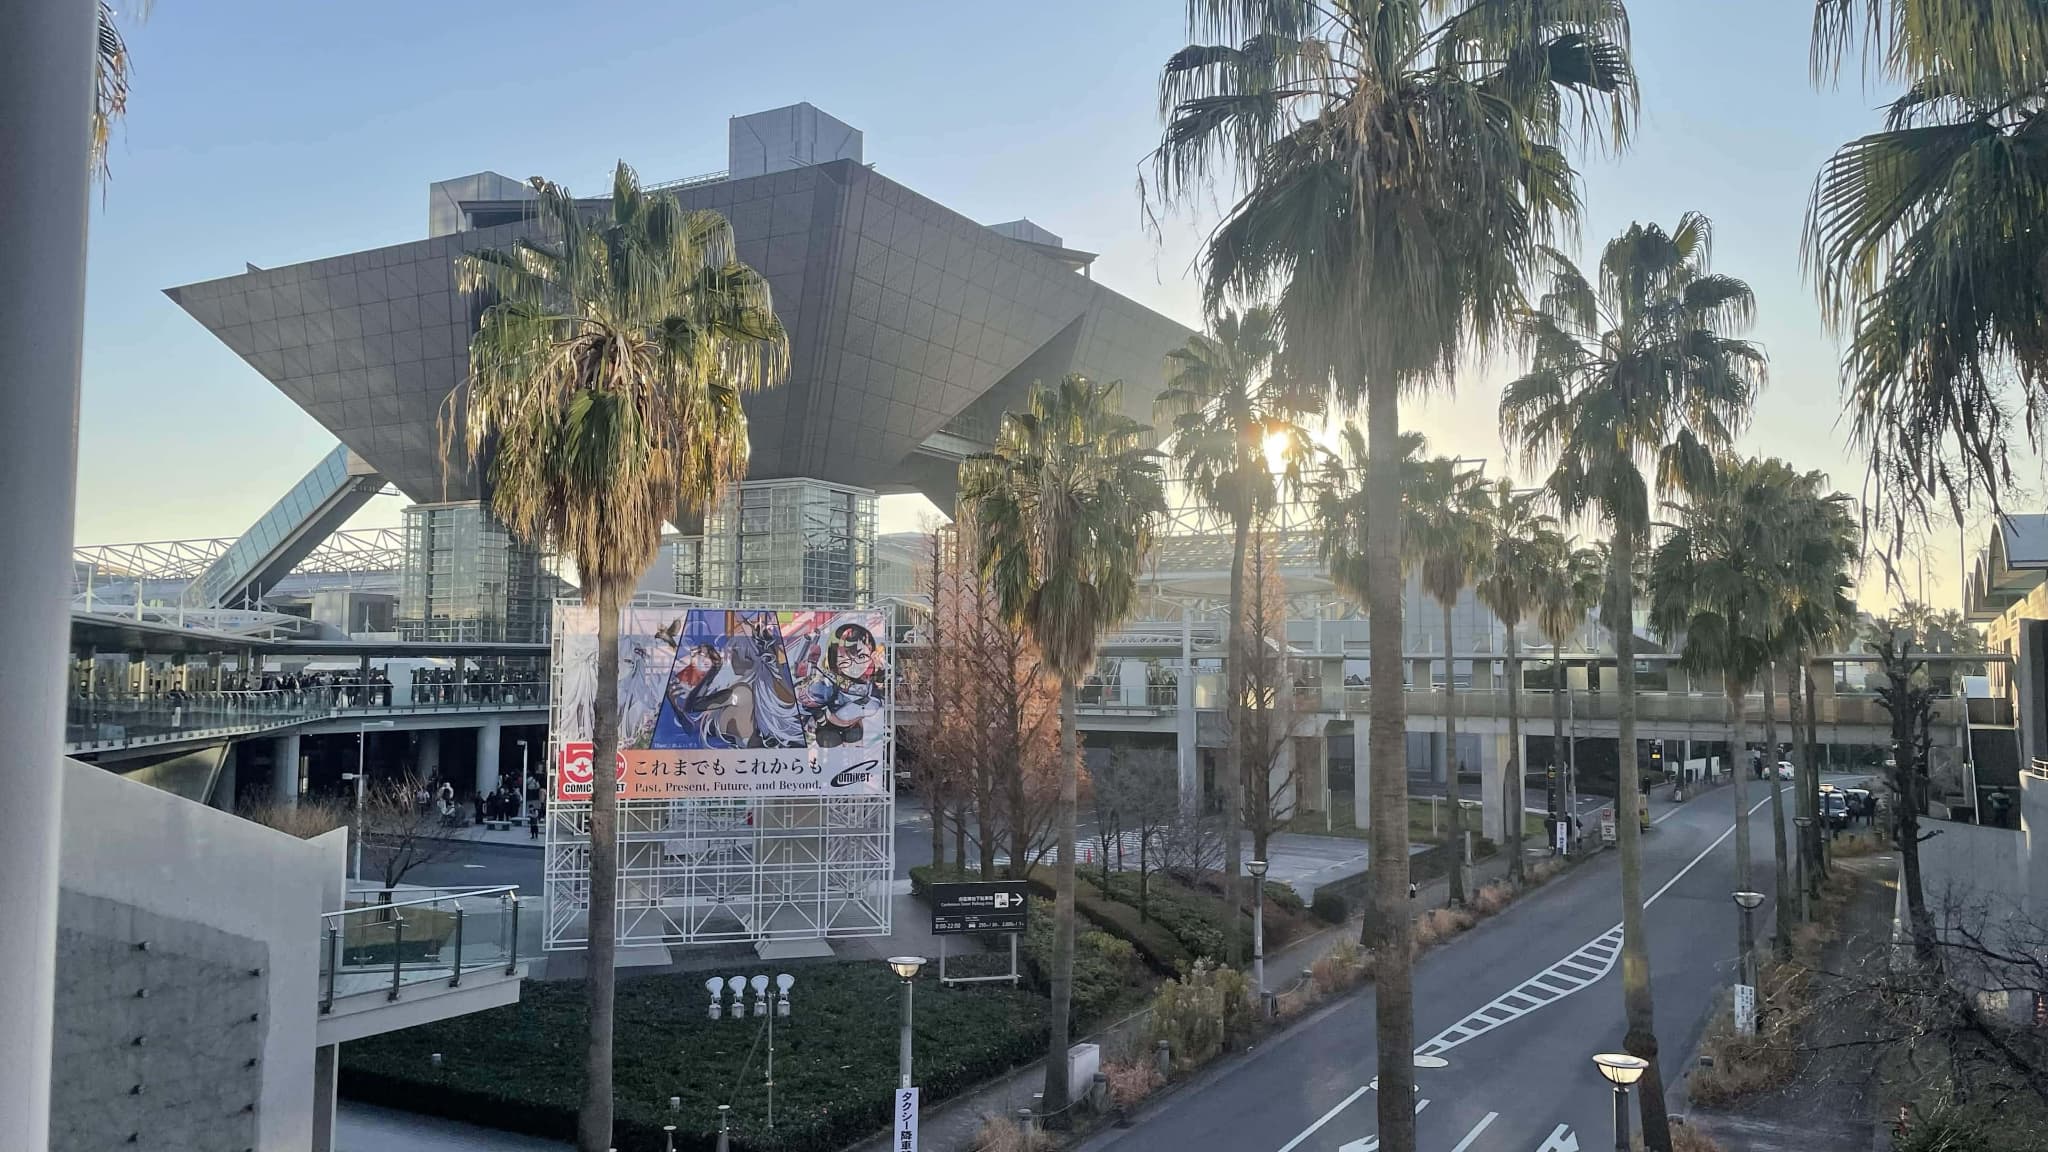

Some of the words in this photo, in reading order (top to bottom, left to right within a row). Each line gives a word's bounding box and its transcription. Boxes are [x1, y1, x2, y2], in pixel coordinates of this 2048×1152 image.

[634, 758, 725, 776] これまでも
[735, 757, 822, 775] これからも
[565, 783, 592, 793] COMIC
[635, 783, 661, 793] Past,
[666, 782, 710, 793] Present,
[714, 781, 752, 792] Future,
[755, 780, 775, 790] and
[779, 779, 822, 792] Beyond.
[901, 1091, 912, 1152] タクシー降車
